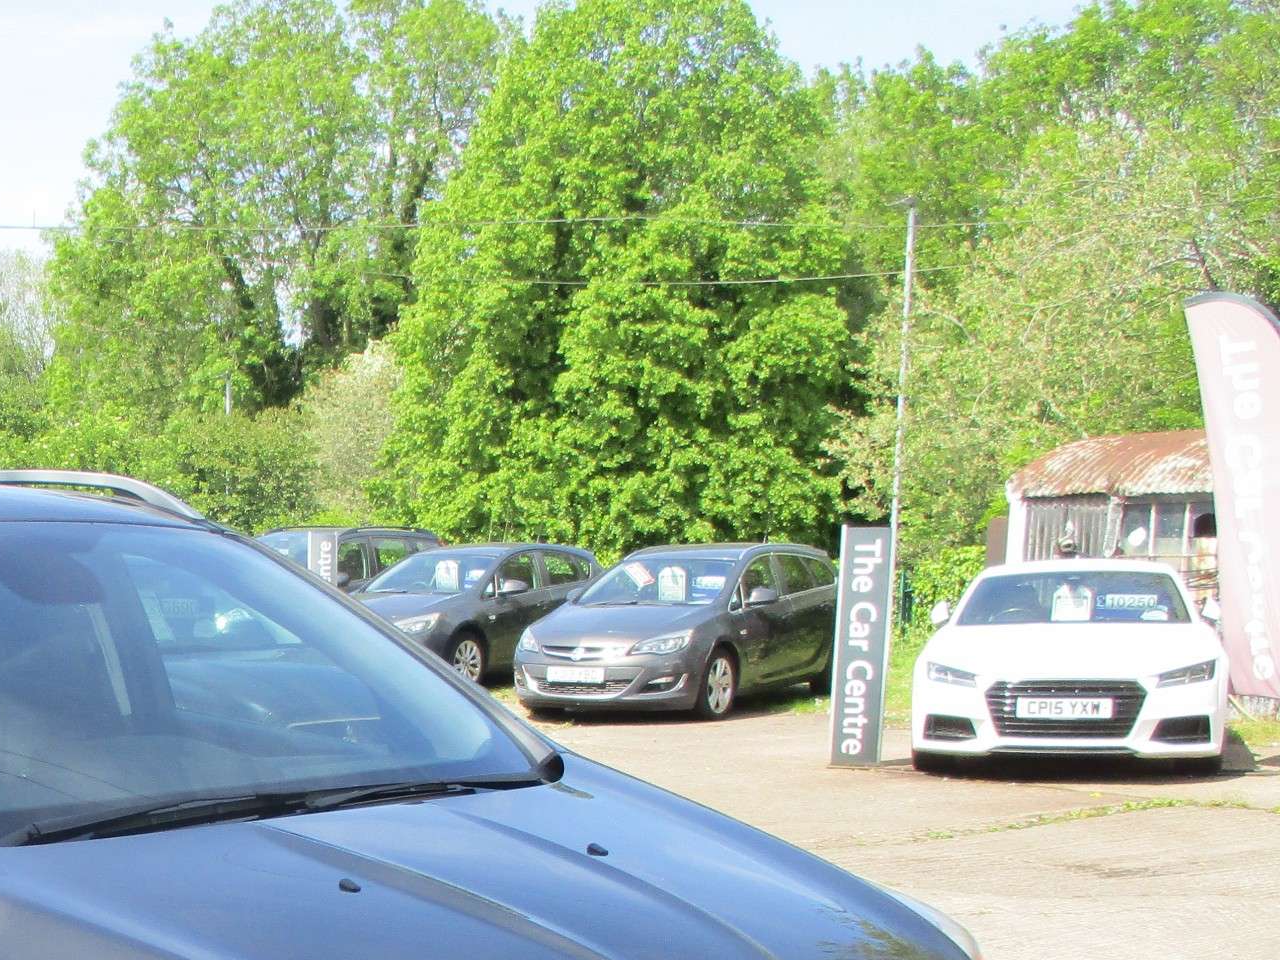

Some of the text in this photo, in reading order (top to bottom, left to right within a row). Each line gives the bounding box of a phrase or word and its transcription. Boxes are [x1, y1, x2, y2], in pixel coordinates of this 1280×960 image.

[317, 540, 333, 582] ntre
[841, 539, 883, 755] The Car Centre
[1027, 701, 1100, 715] CP15 YXW
